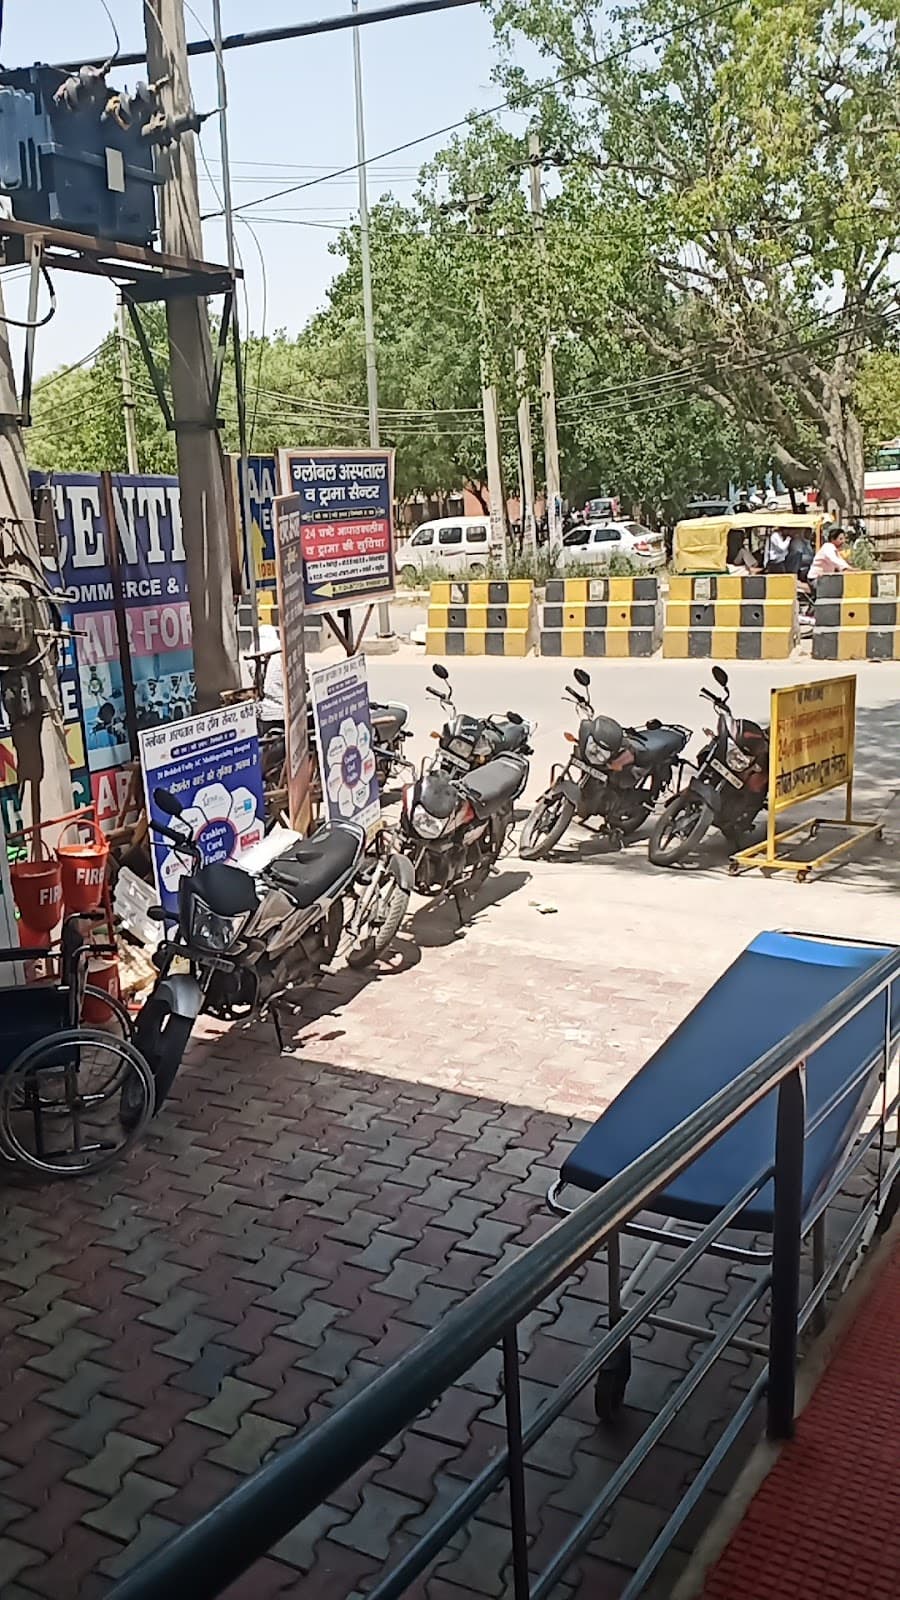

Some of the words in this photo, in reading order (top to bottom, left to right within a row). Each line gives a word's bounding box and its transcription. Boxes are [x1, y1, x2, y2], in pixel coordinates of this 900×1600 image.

[292, 458, 337, 482] ग्लोबल
[338, 463, 387, 481] अस्पताल
[303, 487, 316, 502] व
[303, 527, 316, 540] 24
[166, 577, 180, 594] &
[201, 826, 227, 842] Cashless
[206, 838, 224, 851] Card
[204, 849, 227, 865] Facility
